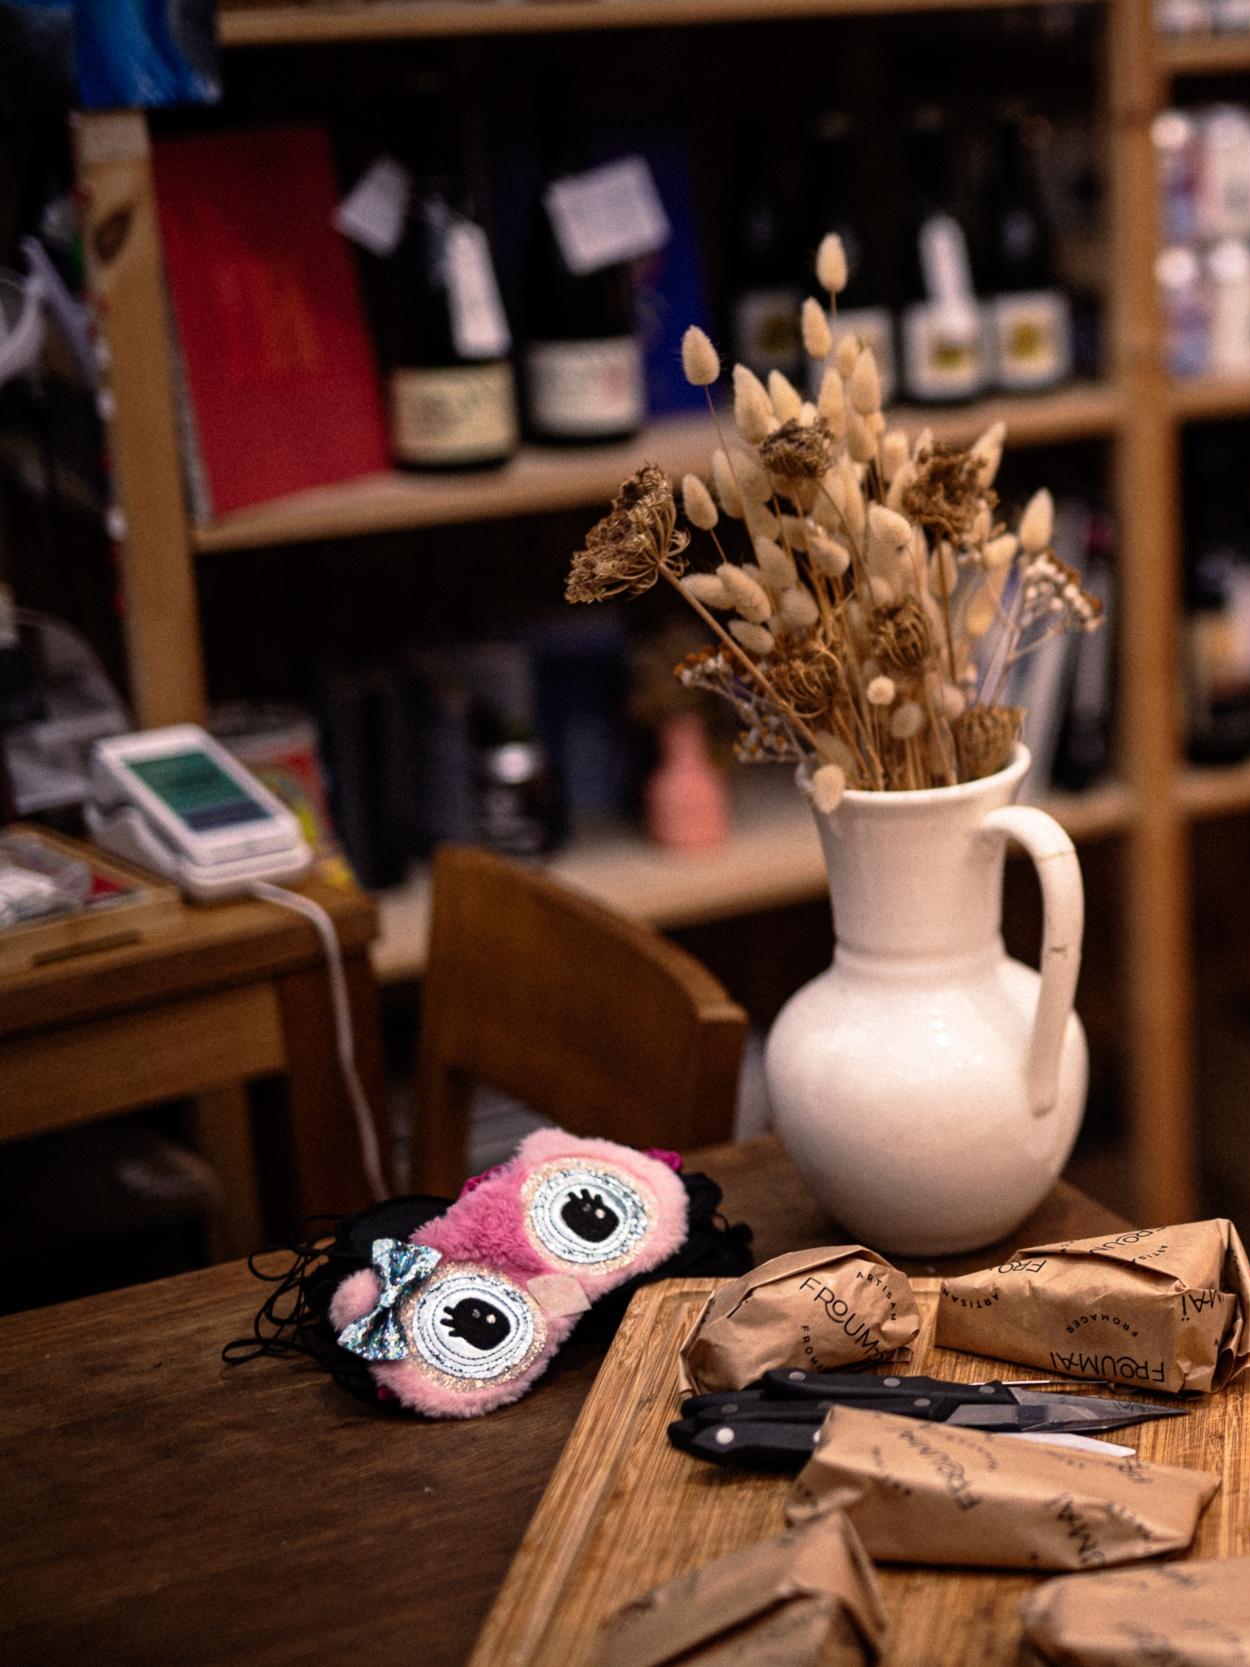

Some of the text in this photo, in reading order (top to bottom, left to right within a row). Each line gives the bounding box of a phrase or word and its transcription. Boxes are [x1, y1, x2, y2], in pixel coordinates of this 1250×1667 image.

[998, 1259, 1048, 1274] FRO
[856, 1271, 898, 1321] ARTISAN
[942, 1286, 999, 1309] ARTISAN
[1065, 1312, 1139, 1338] FROMAGER
